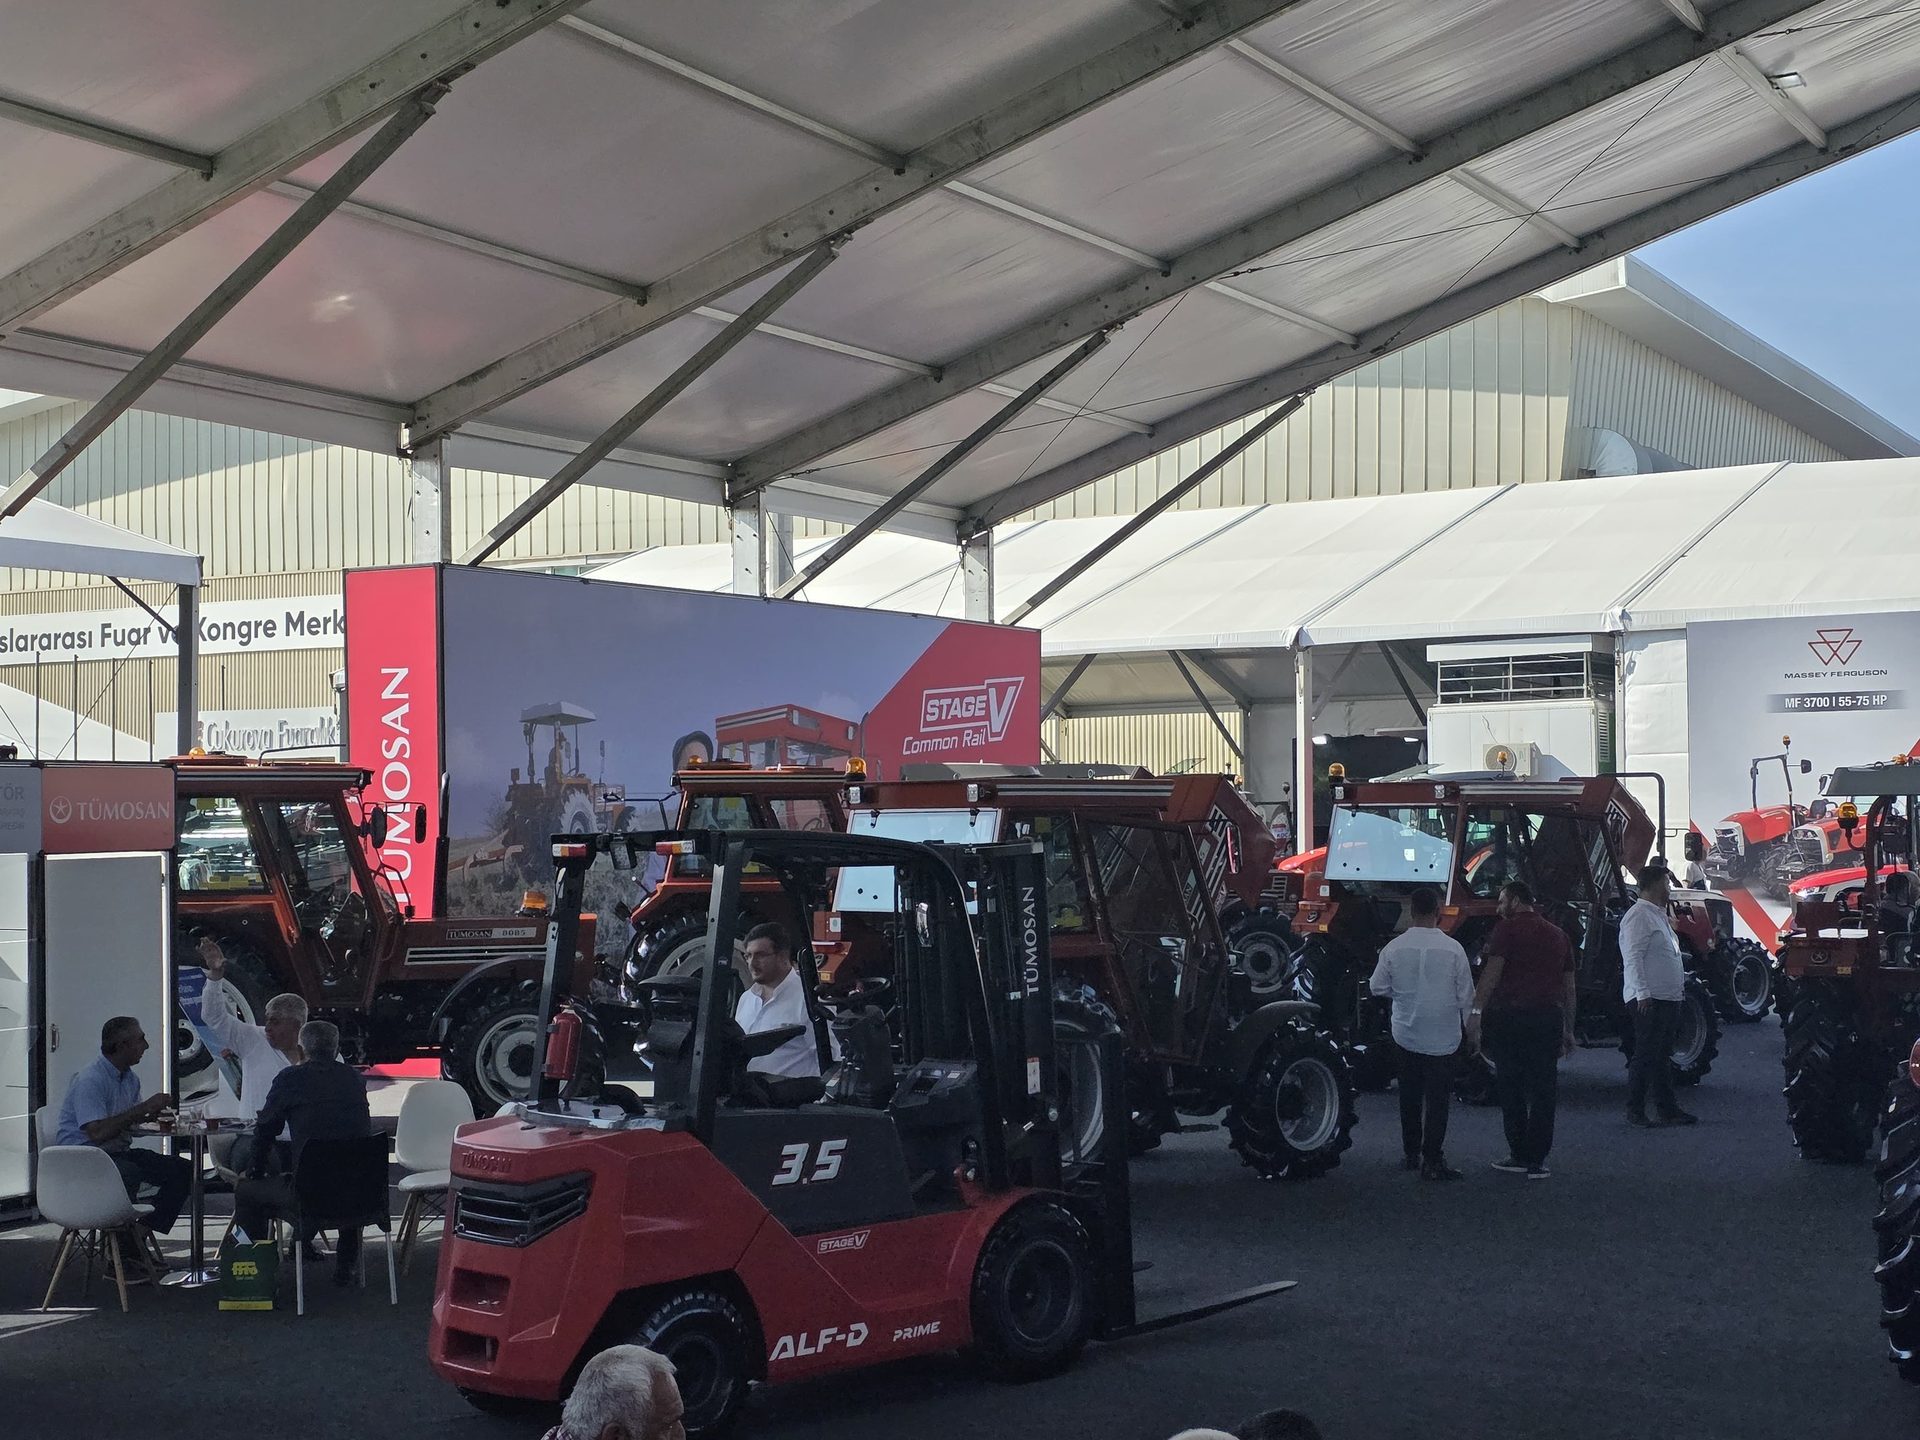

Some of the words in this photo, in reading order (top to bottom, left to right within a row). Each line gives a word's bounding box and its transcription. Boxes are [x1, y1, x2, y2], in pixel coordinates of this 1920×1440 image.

[101, 623, 151, 647] Fuar
[1830, 669, 1888, 677] FERGUSON
[926, 694, 987, 722] STAGE
[1785, 697, 1801, 708] MF
[1803, 697, 1830, 708] 3700
[1838, 695, 1870, 706] 55-75
[1872, 694, 1888, 706] HP
[902, 736, 959, 755] Common
[962, 728, 986, 748] Rail
[77, 798, 170, 820] TÜMOSAN
[1022, 887, 1040, 997] TÜMOSAN
[772, 1139, 848, 1185] 3.5
[820, 1238, 854, 1251] STAGE
[768, 1322, 869, 1362] ALF-D
[892, 1321, 941, 1342] PRIME
